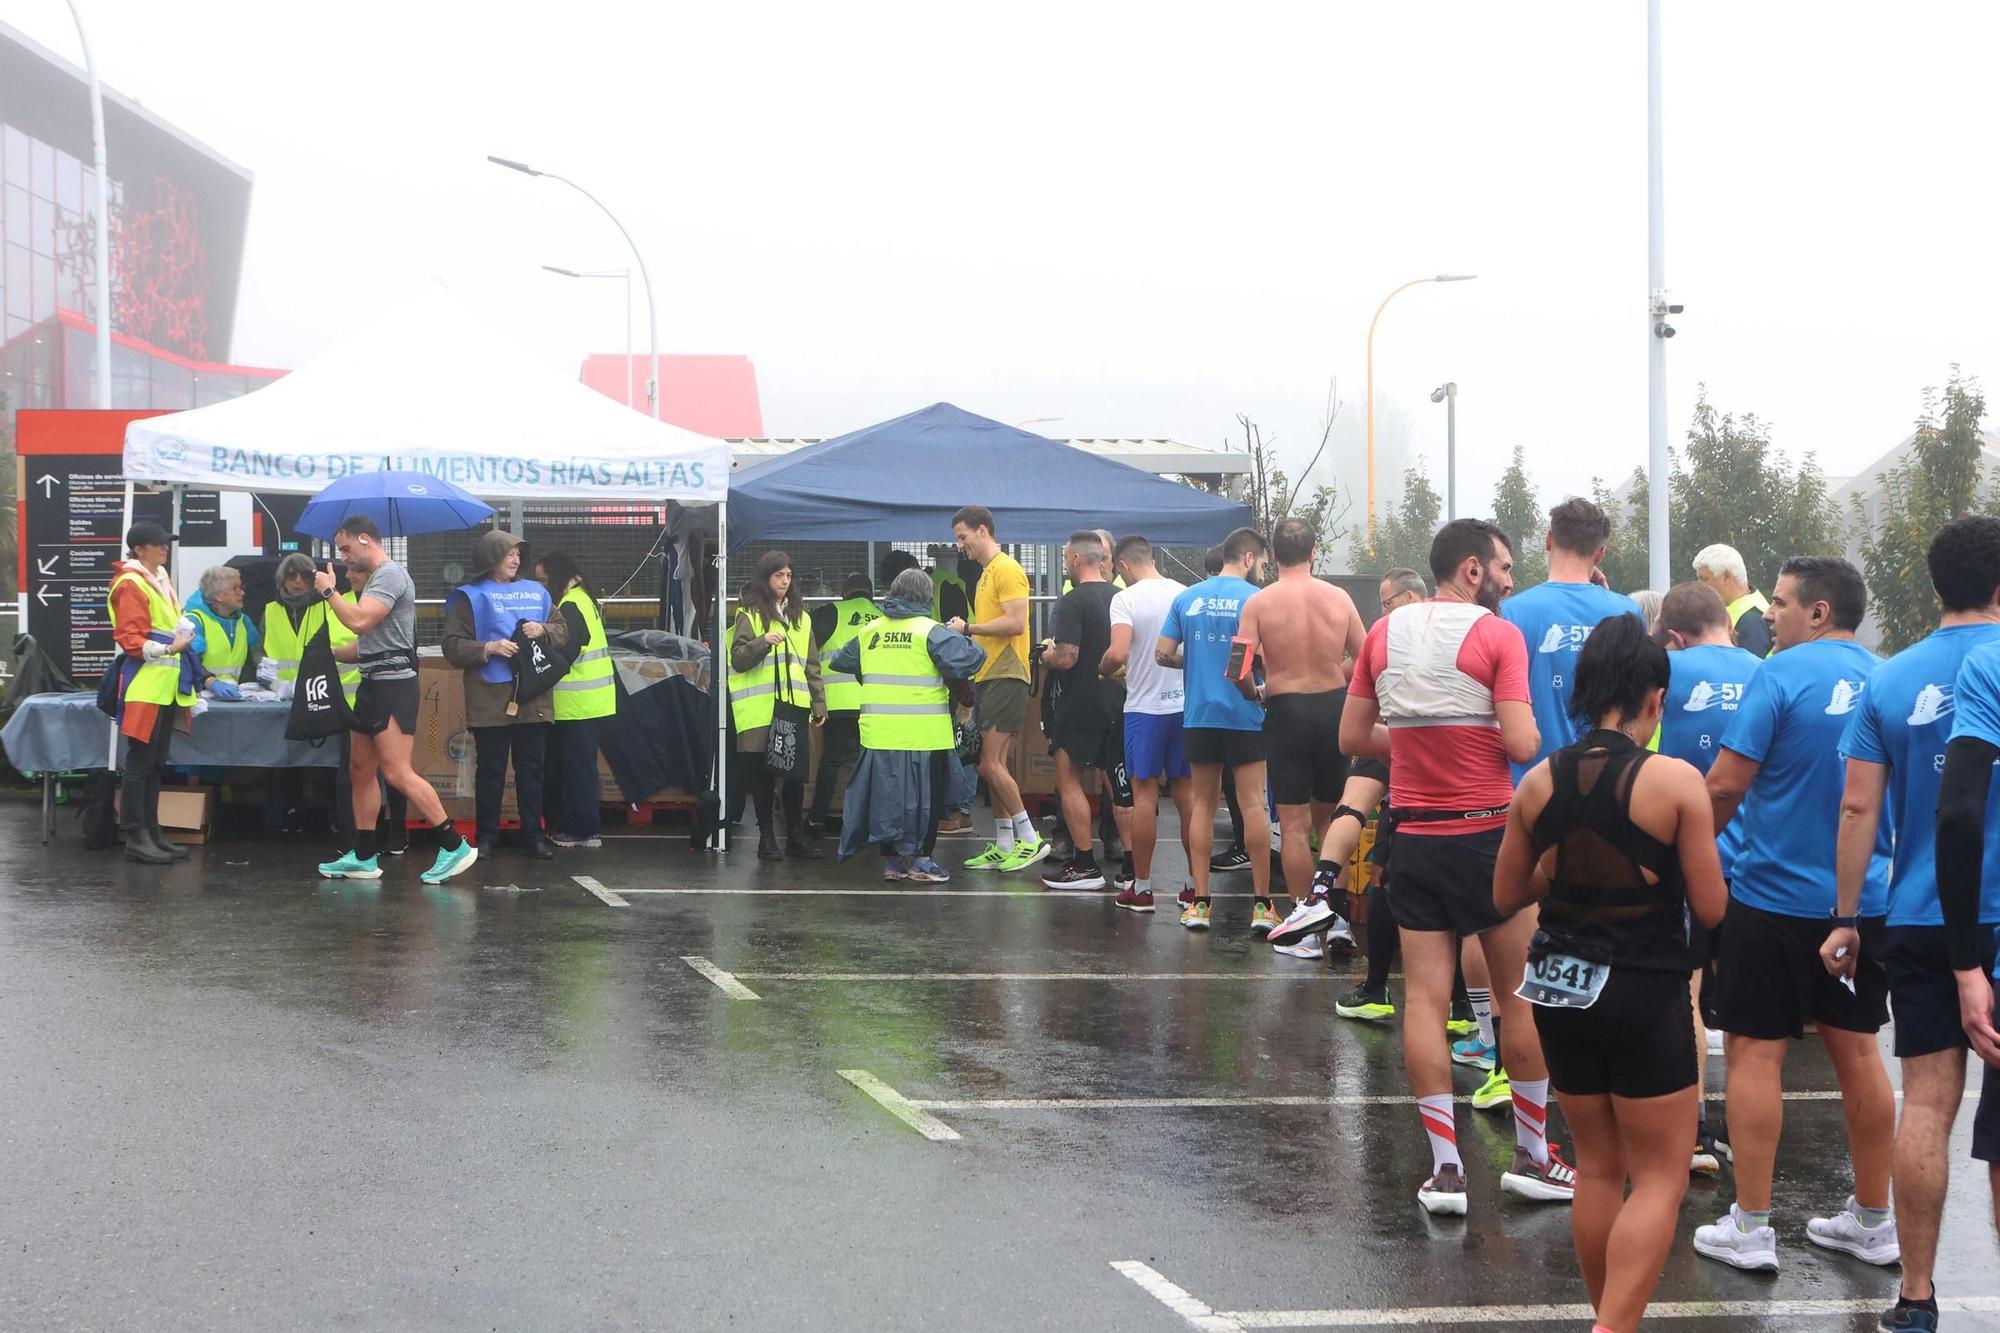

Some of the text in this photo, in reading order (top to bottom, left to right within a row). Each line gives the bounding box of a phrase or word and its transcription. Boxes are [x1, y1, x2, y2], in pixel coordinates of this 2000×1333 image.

[211, 446, 316, 479] BANCO
[327, 454, 364, 480] DE
[551, 455, 613, 486] RÍAS
[621, 460, 705, 489] ALTAS
[1207, 598, 1240, 611] 5KM
[884, 632, 913, 643] 5KM
[1534, 957, 1594, 992] 0541
